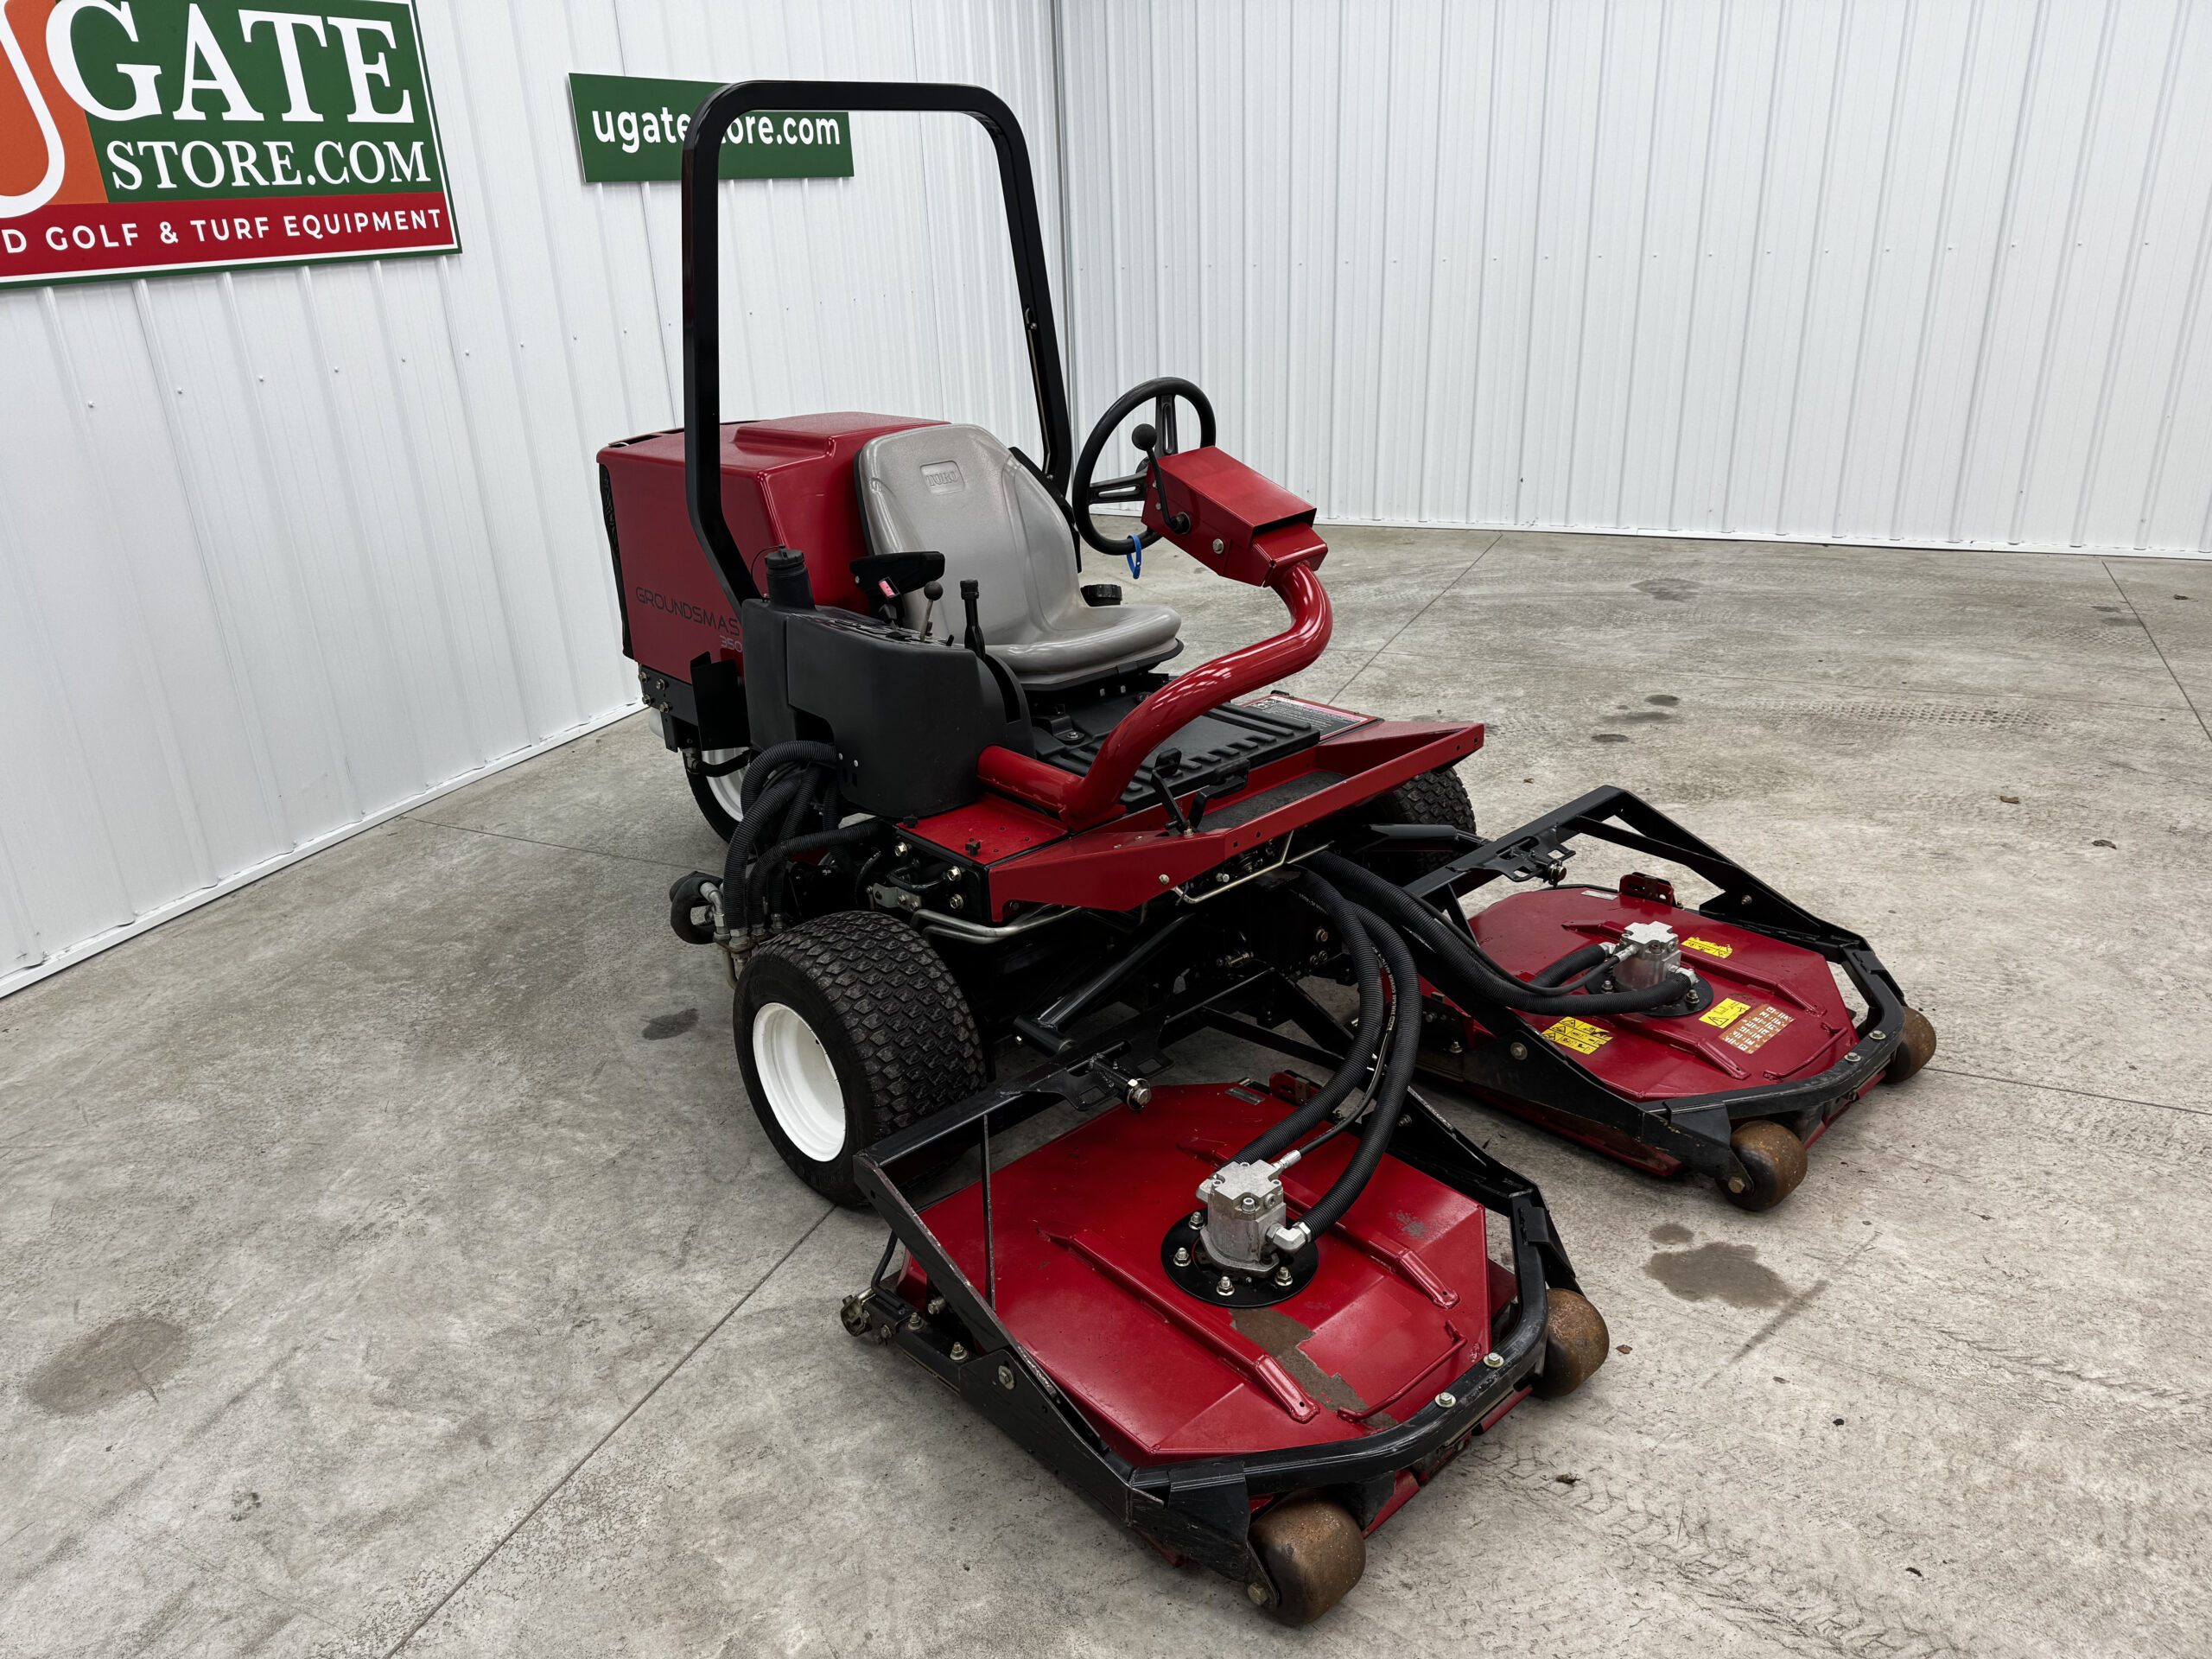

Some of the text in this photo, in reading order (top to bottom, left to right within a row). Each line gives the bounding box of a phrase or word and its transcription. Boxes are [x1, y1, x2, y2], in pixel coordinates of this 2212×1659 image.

[592, 107, 841, 154] ugateore.com
[106, 139, 432, 191] STORE.COM
[45, 222, 140, 251] GOLF
[159, 221, 179, 245] &
[190, 216, 270, 243] TURF
[283, 208, 442, 239] EQUIPMENT
